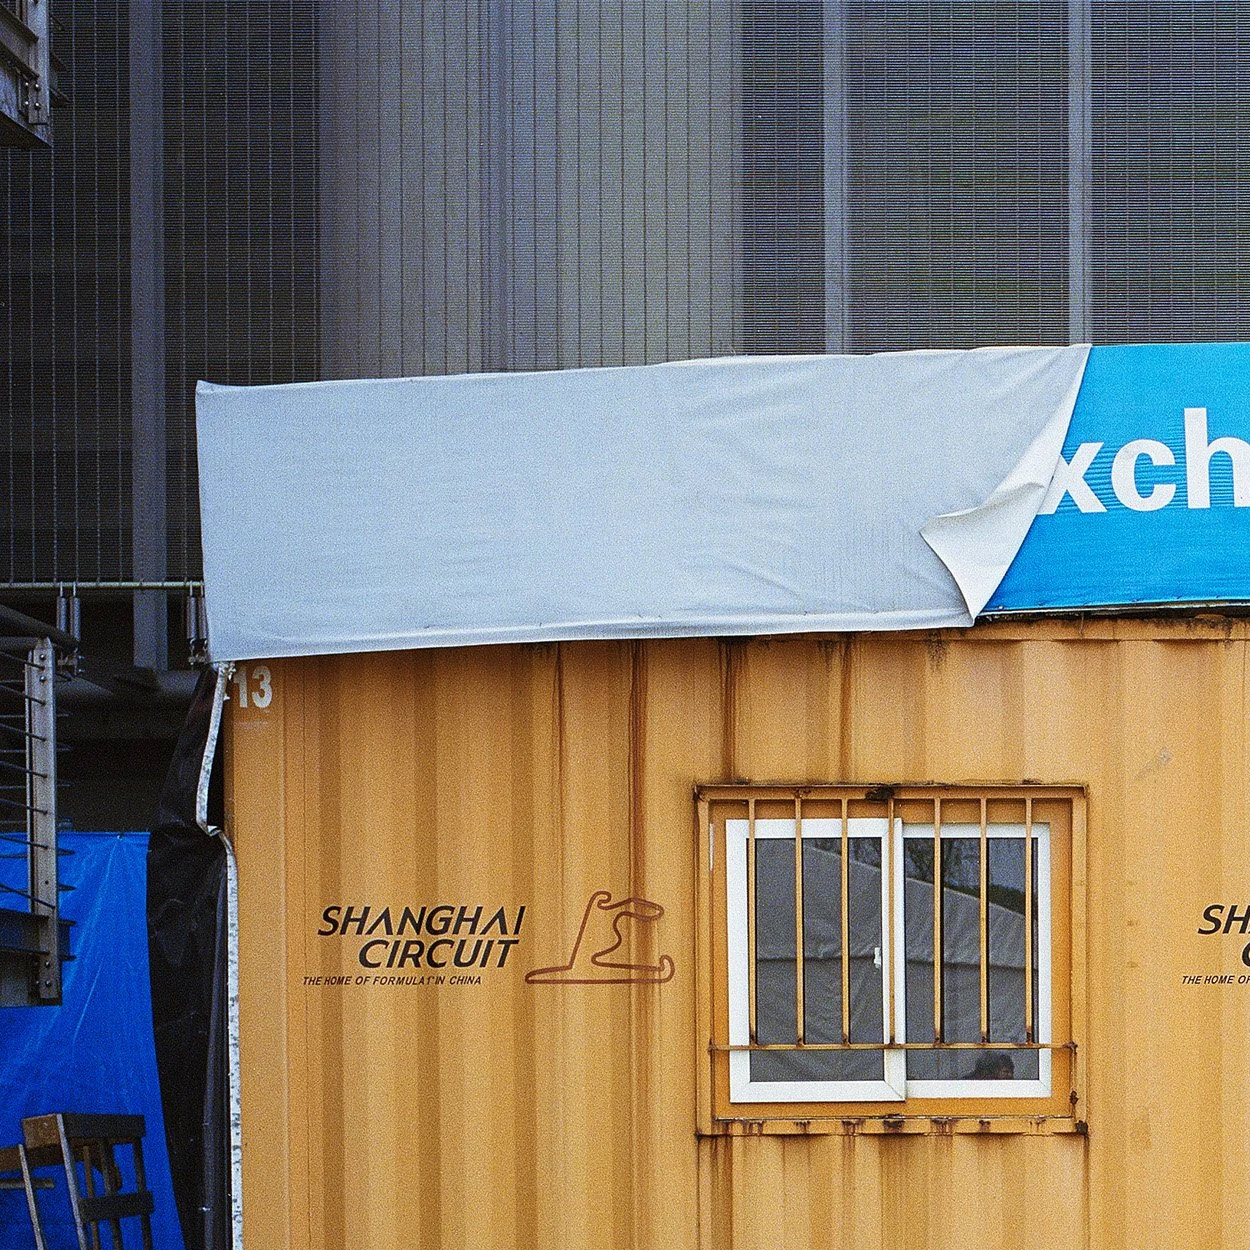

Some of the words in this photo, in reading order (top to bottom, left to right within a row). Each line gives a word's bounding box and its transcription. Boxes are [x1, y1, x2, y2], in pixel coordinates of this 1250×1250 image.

[233, 665, 272, 708] 13
[317, 906, 526, 936] SHANGHAI
[358, 939, 519, 969] CIRCUIT
[303, 976, 322, 986] THE
[324, 976, 352, 986] HOME
[355, 975, 371, 985] OF
[373, 976, 425, 985] FORMULA
[449, 976, 482, 985] CHINA
[1182, 975, 1202, 985] THE
[1204, 975, 1235, 985] HOME
